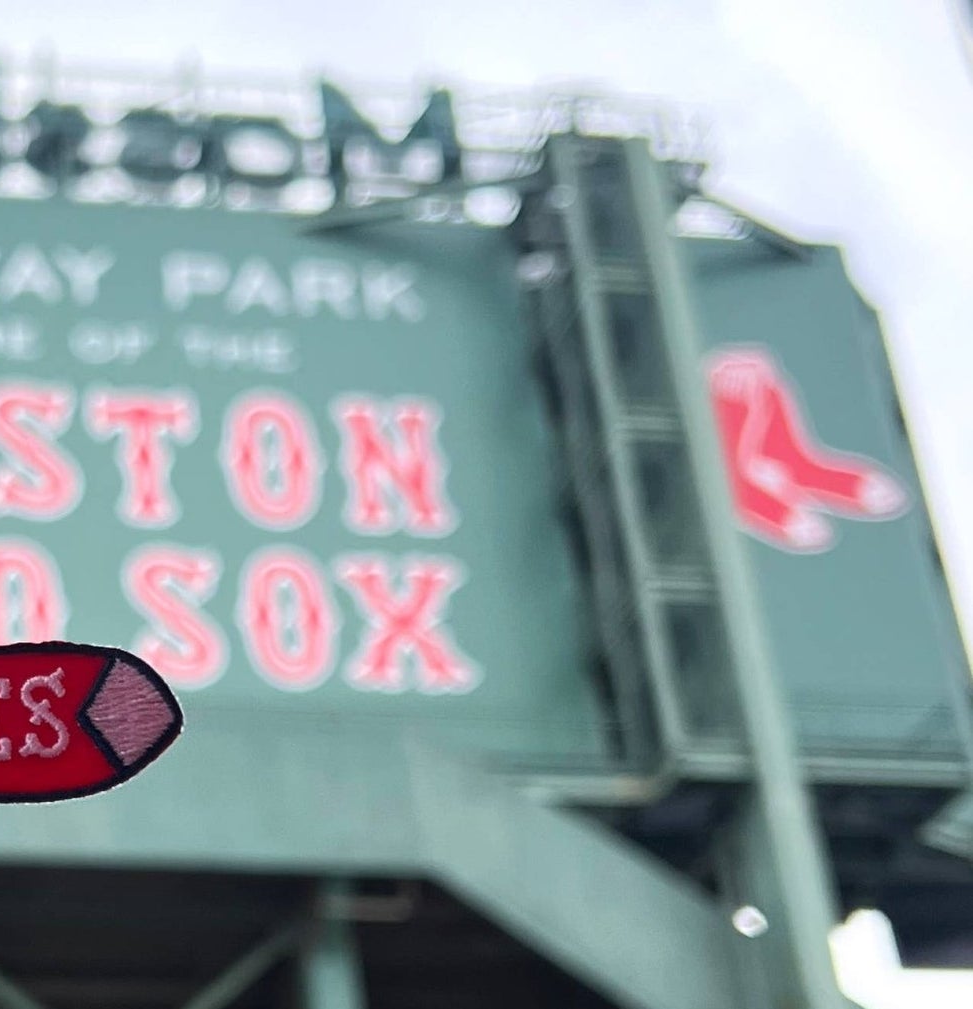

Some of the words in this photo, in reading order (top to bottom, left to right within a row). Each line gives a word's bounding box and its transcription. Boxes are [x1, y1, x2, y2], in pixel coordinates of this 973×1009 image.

[159, 249, 425, 322] PARK
[66, 320, 153, 365] OF
[179, 323, 297, 374] THE
[121, 546, 481, 692] SOX
